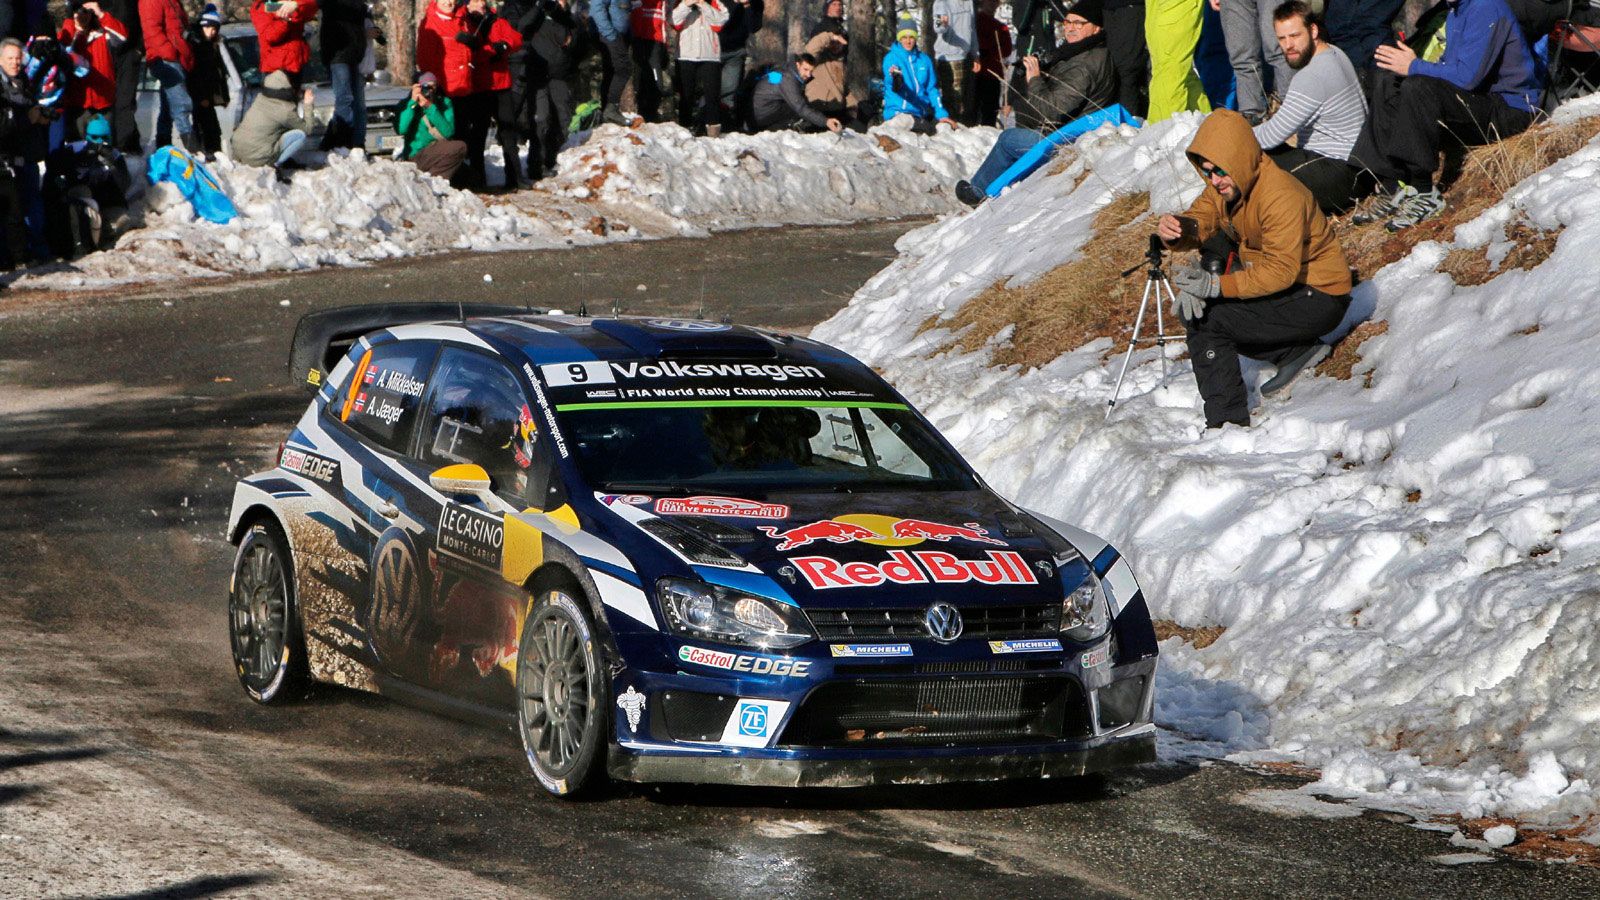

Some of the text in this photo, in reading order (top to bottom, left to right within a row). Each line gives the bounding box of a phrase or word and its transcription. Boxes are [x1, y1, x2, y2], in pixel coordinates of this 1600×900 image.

[376, 368, 425, 397] A. Mikkelsen
[567, 363, 588, 383] 9
[610, 361, 825, 381] Volkswagen
[627, 389, 652, 397] FIA
[653, 388, 694, 397] World
[697, 387, 730, 397] Rally
[733, 386, 822, 398] Championship
[366, 396, 404, 425] A. Jæger
[522, 362, 569, 459] www.volkswagen-motorsport.com
[301, 455, 338, 482] EDGE
[661, 502, 699, 513] RALLYE
[442, 507, 503, 548] LE CASINO
[788, 550, 1039, 589] Red Bull
[1012, 641, 1059, 649] MICHELIN
[690, 649, 812, 677] Castrol EDGE
[743, 710, 767, 730] ZF
